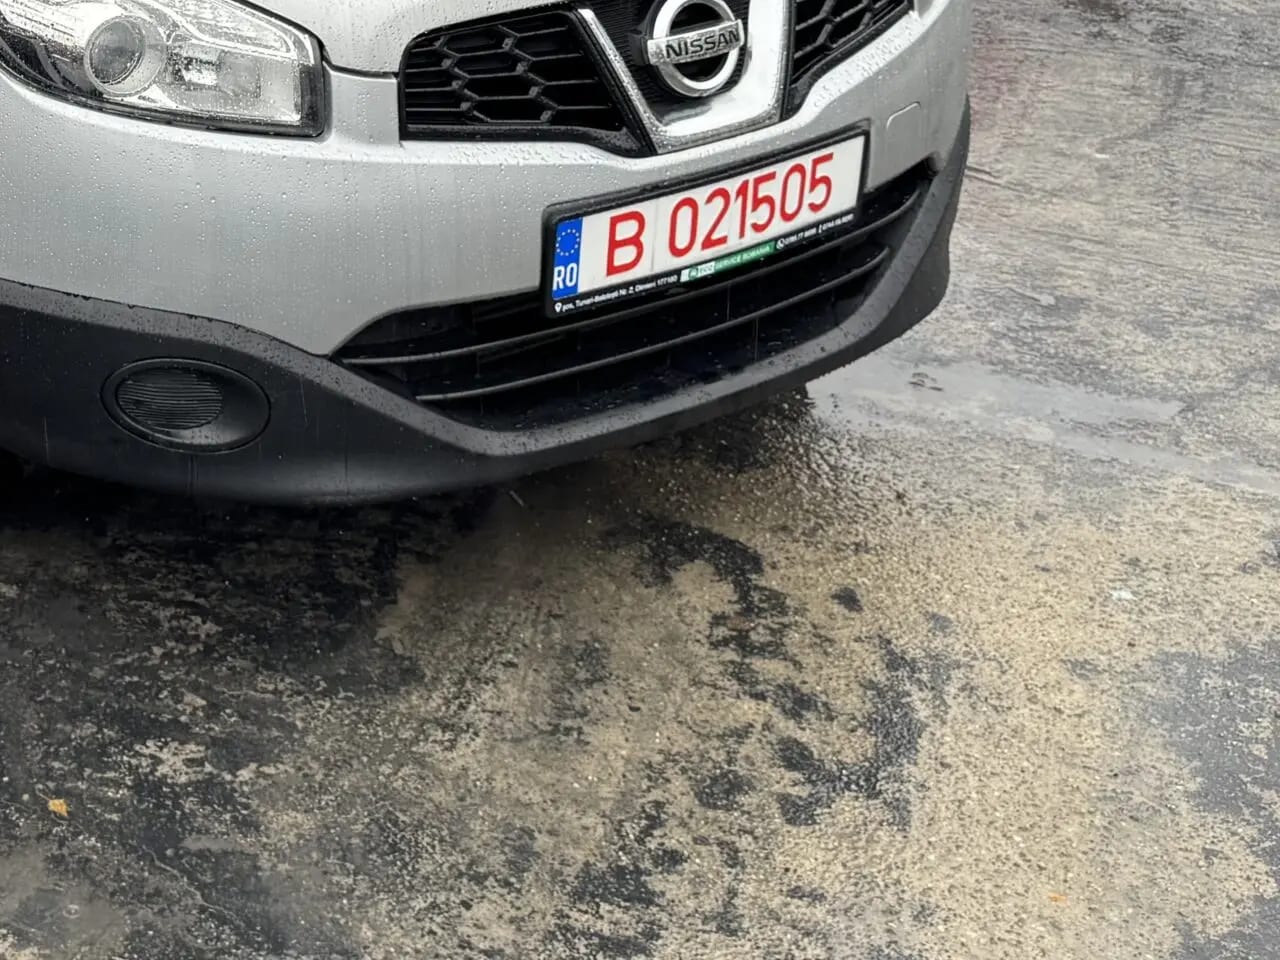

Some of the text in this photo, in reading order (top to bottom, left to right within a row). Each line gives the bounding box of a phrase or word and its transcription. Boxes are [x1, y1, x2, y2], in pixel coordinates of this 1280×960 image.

[665, 29, 740, 59] NISSAN
[606, 152, 835, 277] B 021505
[552, 262, 578, 291] RO
